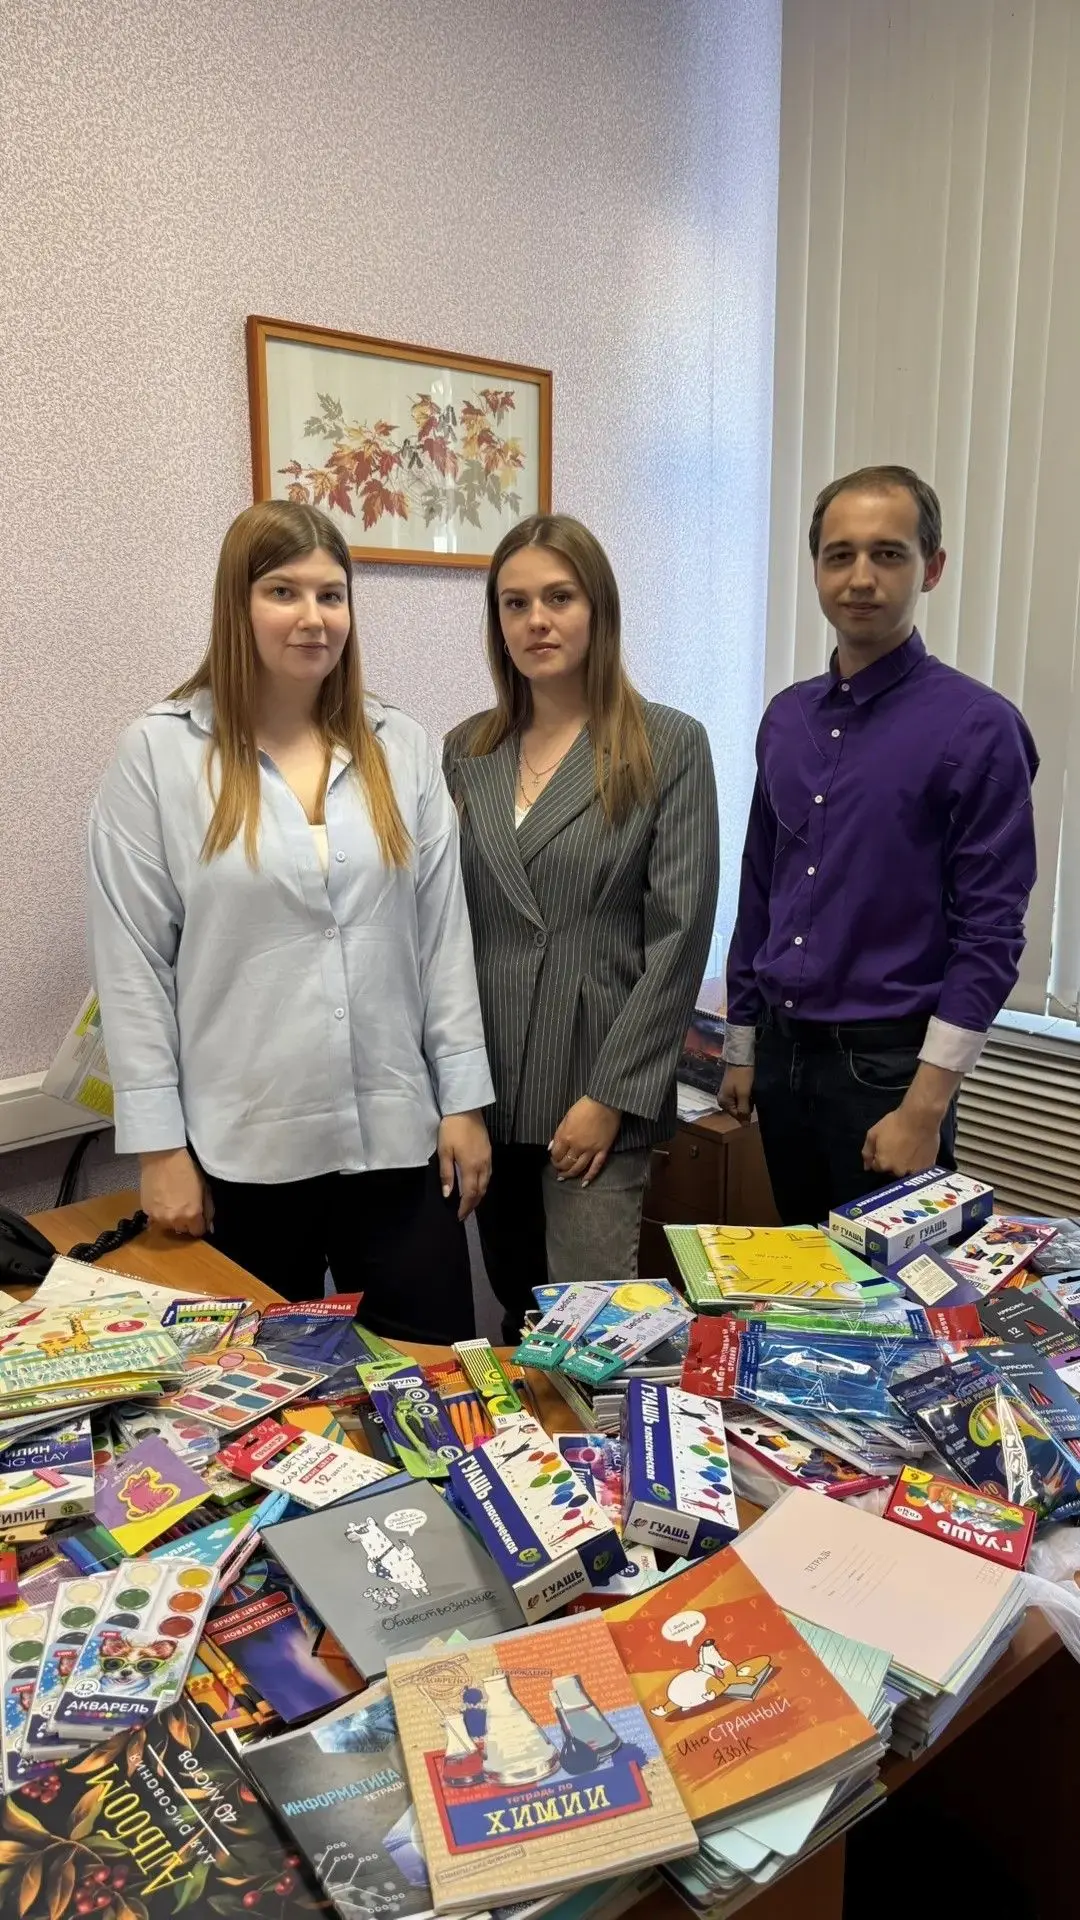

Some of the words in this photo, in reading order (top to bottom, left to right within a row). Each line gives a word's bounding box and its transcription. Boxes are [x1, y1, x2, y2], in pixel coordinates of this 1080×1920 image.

[903, 1168, 946, 1187] ГУАШЬ
[840, 1227, 864, 1243] ГУАШЬ
[919, 1219, 947, 1239] ГУАШЬ
[1008, 1327, 1020, 1336] 12
[373, 1378, 419, 1388] ЦИРКУЛЬ
[641, 1384, 660, 1425] ГУАШЬ
[32, 1452, 69, 1464] CLAY
[643, 1425, 656, 1480] классическая
[315, 1474, 331, 1486] 12
[63, 1505, 73, 1514] 12
[458, 1455, 492, 1501] ГУАШЬ
[482, 1499, 518, 1555] классическая
[650, 1519, 690, 1540] ГУАШЬ
[937, 1520, 1014, 1553] ГУАШЬ
[703, 1540, 714, 1548] 12
[804, 1550, 832, 1573] ТЕТРАДЬ
[542, 1568, 583, 1598] ГУАШЬ
[213, 1613, 240, 1628] ЯРКИЕ
[242, 1602, 268, 1616] ЦВЕТА
[381, 1591, 497, 1631] Обществознание
[223, 1624, 254, 1640] НОВАЯ
[254, 1607, 293, 1628] ПАЛИТРА
[66, 1700, 149, 1714] АКВАРЕЛЬ
[712, 1737, 757, 1766] ЯЗЫК
[129, 1753, 196, 1837] рисования
[506, 1788, 555, 1804] тетрадь
[558, 1782, 573, 1792] по
[213, 1803, 237, 1824] 40
[483, 1784, 611, 1836] ХИМИИ
[85, 1763, 194, 1896] Альбом
[188, 1838, 216, 1865] для
